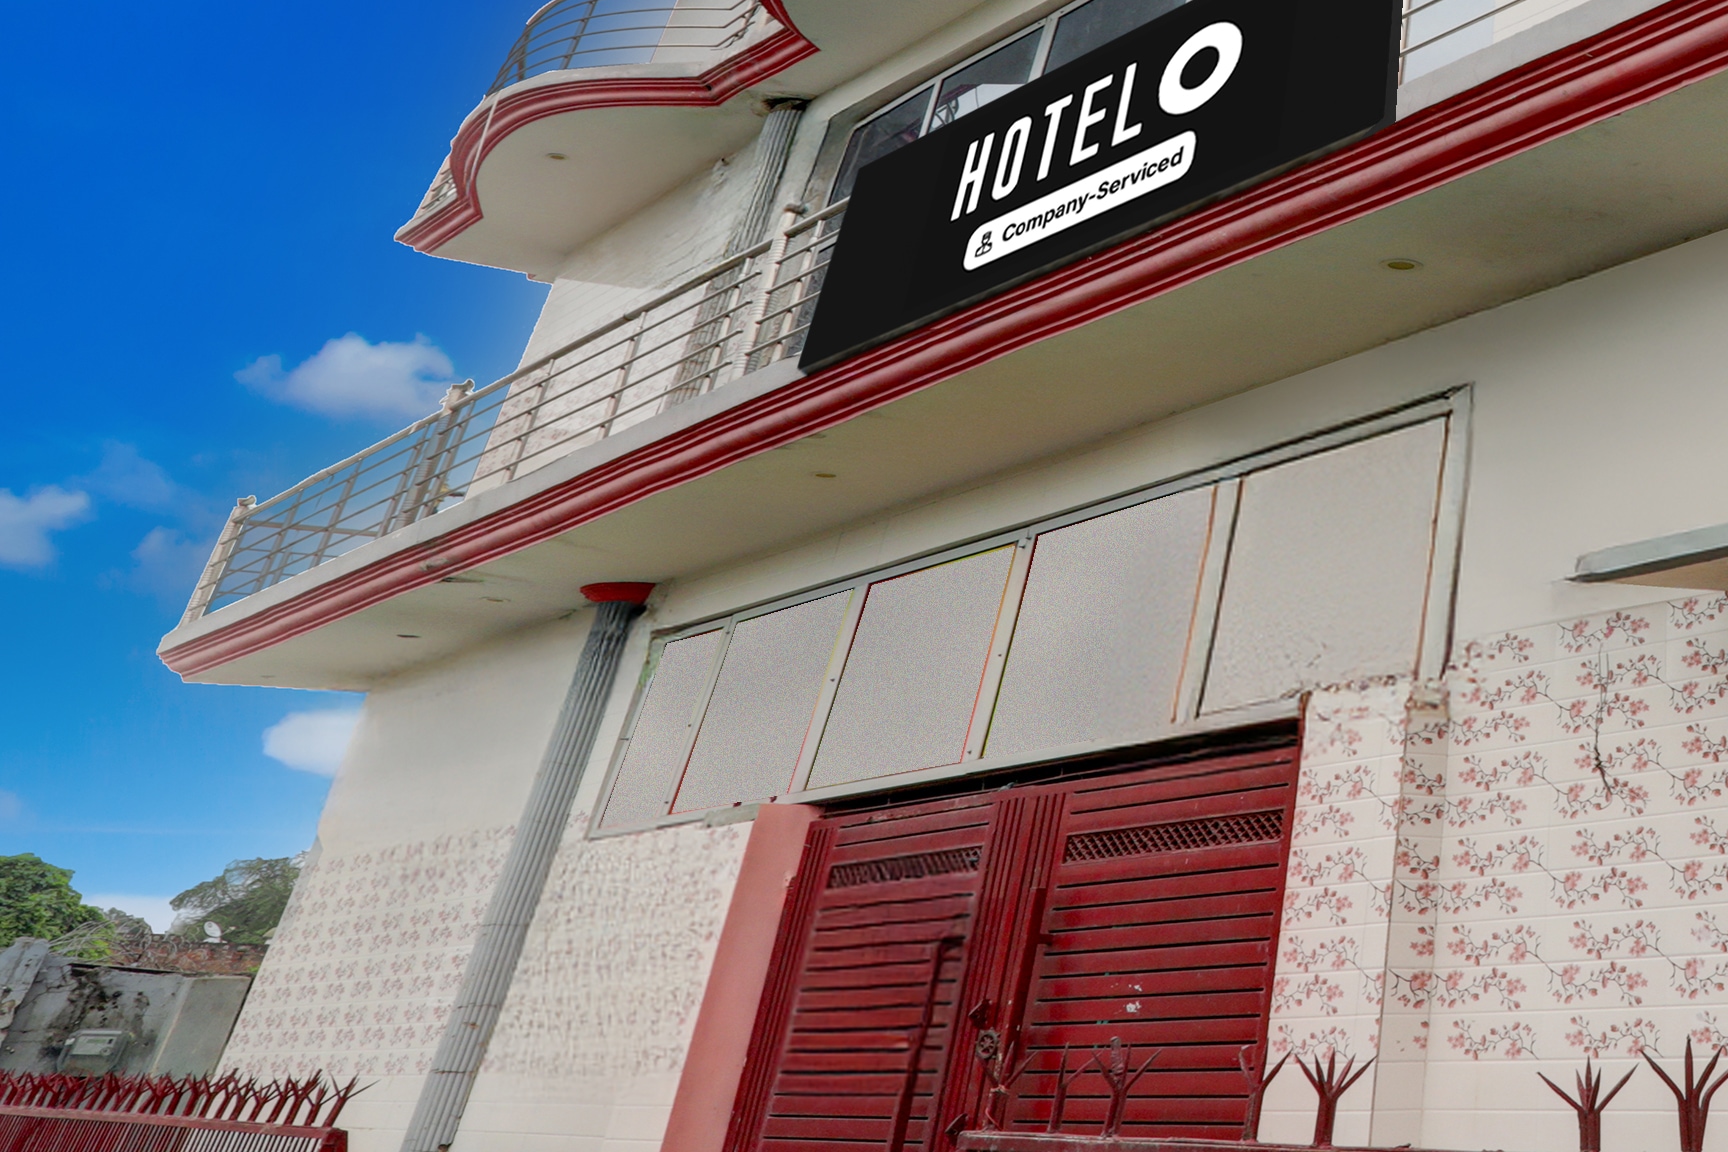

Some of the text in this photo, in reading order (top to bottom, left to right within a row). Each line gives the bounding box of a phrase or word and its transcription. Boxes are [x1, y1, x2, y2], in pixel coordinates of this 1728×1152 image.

[951, 22, 1242, 221] HOTEL O
[1002, 146, 1184, 242] Company-Serviced
